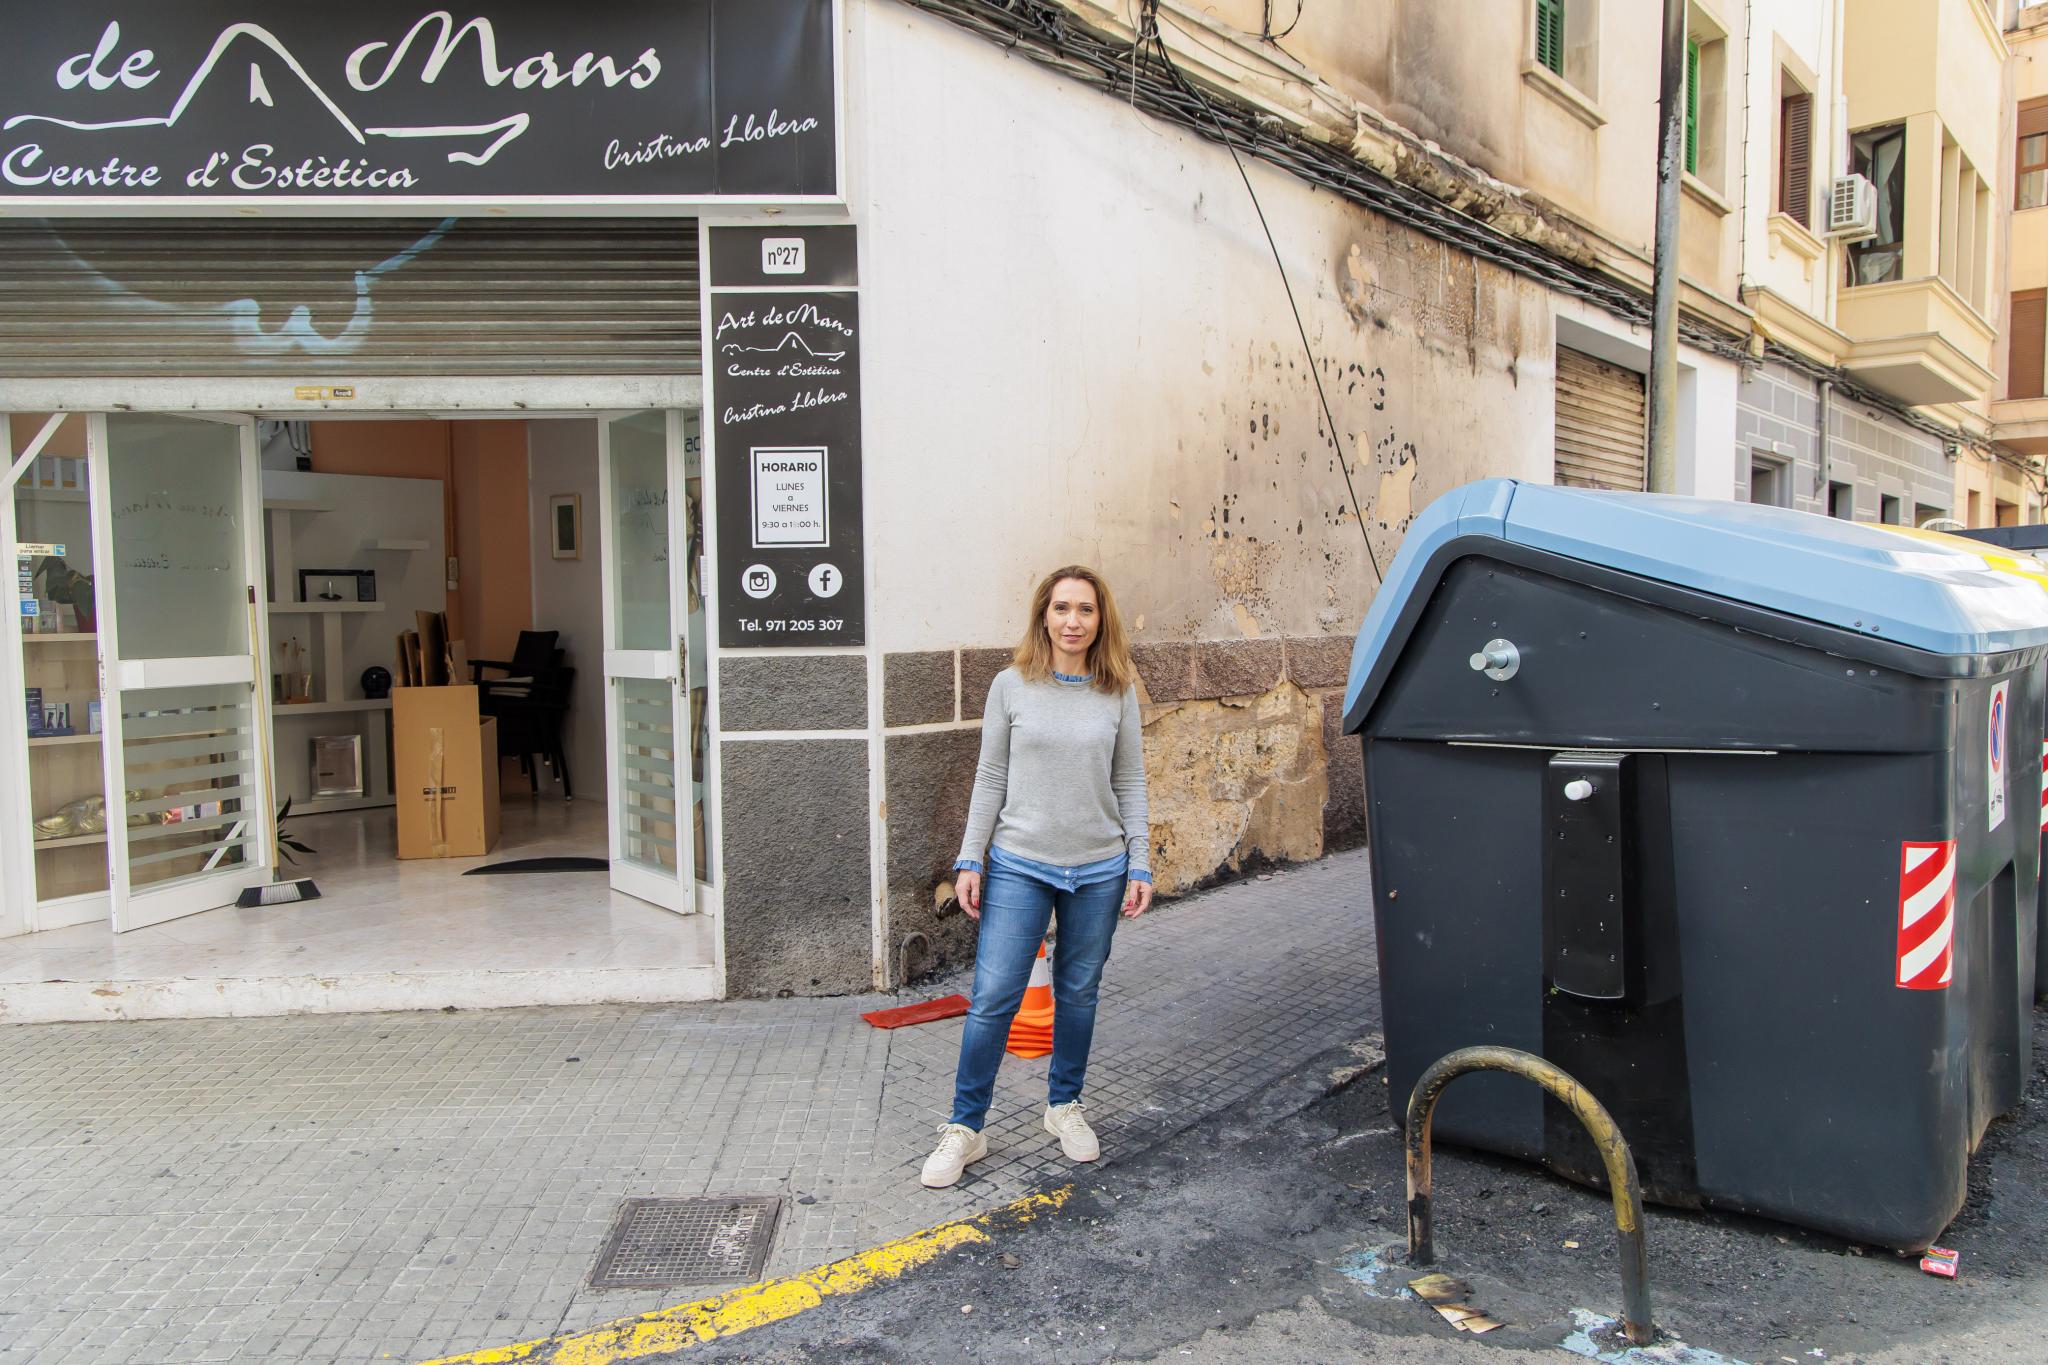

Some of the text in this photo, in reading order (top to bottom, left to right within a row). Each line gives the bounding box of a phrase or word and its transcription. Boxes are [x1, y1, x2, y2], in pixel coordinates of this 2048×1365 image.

[57, 11, 661, 91] de Mans
[605, 109, 818, 169] Cristina Llobera
[2, 142, 418, 189] Centre d'Estètica
[716, 312, 756, 340] Art
[762, 306, 784, 325] de
[728, 363, 841, 376] Centre d'Estètica
[724, 388, 848, 424] Cristina Llobera
[761, 462, 818, 473] HORARIO
[776, 482, 805, 491] LUNES
[772, 504, 809, 512] VIERNES
[739, 619, 843, 631] Tel. 971 205 307
